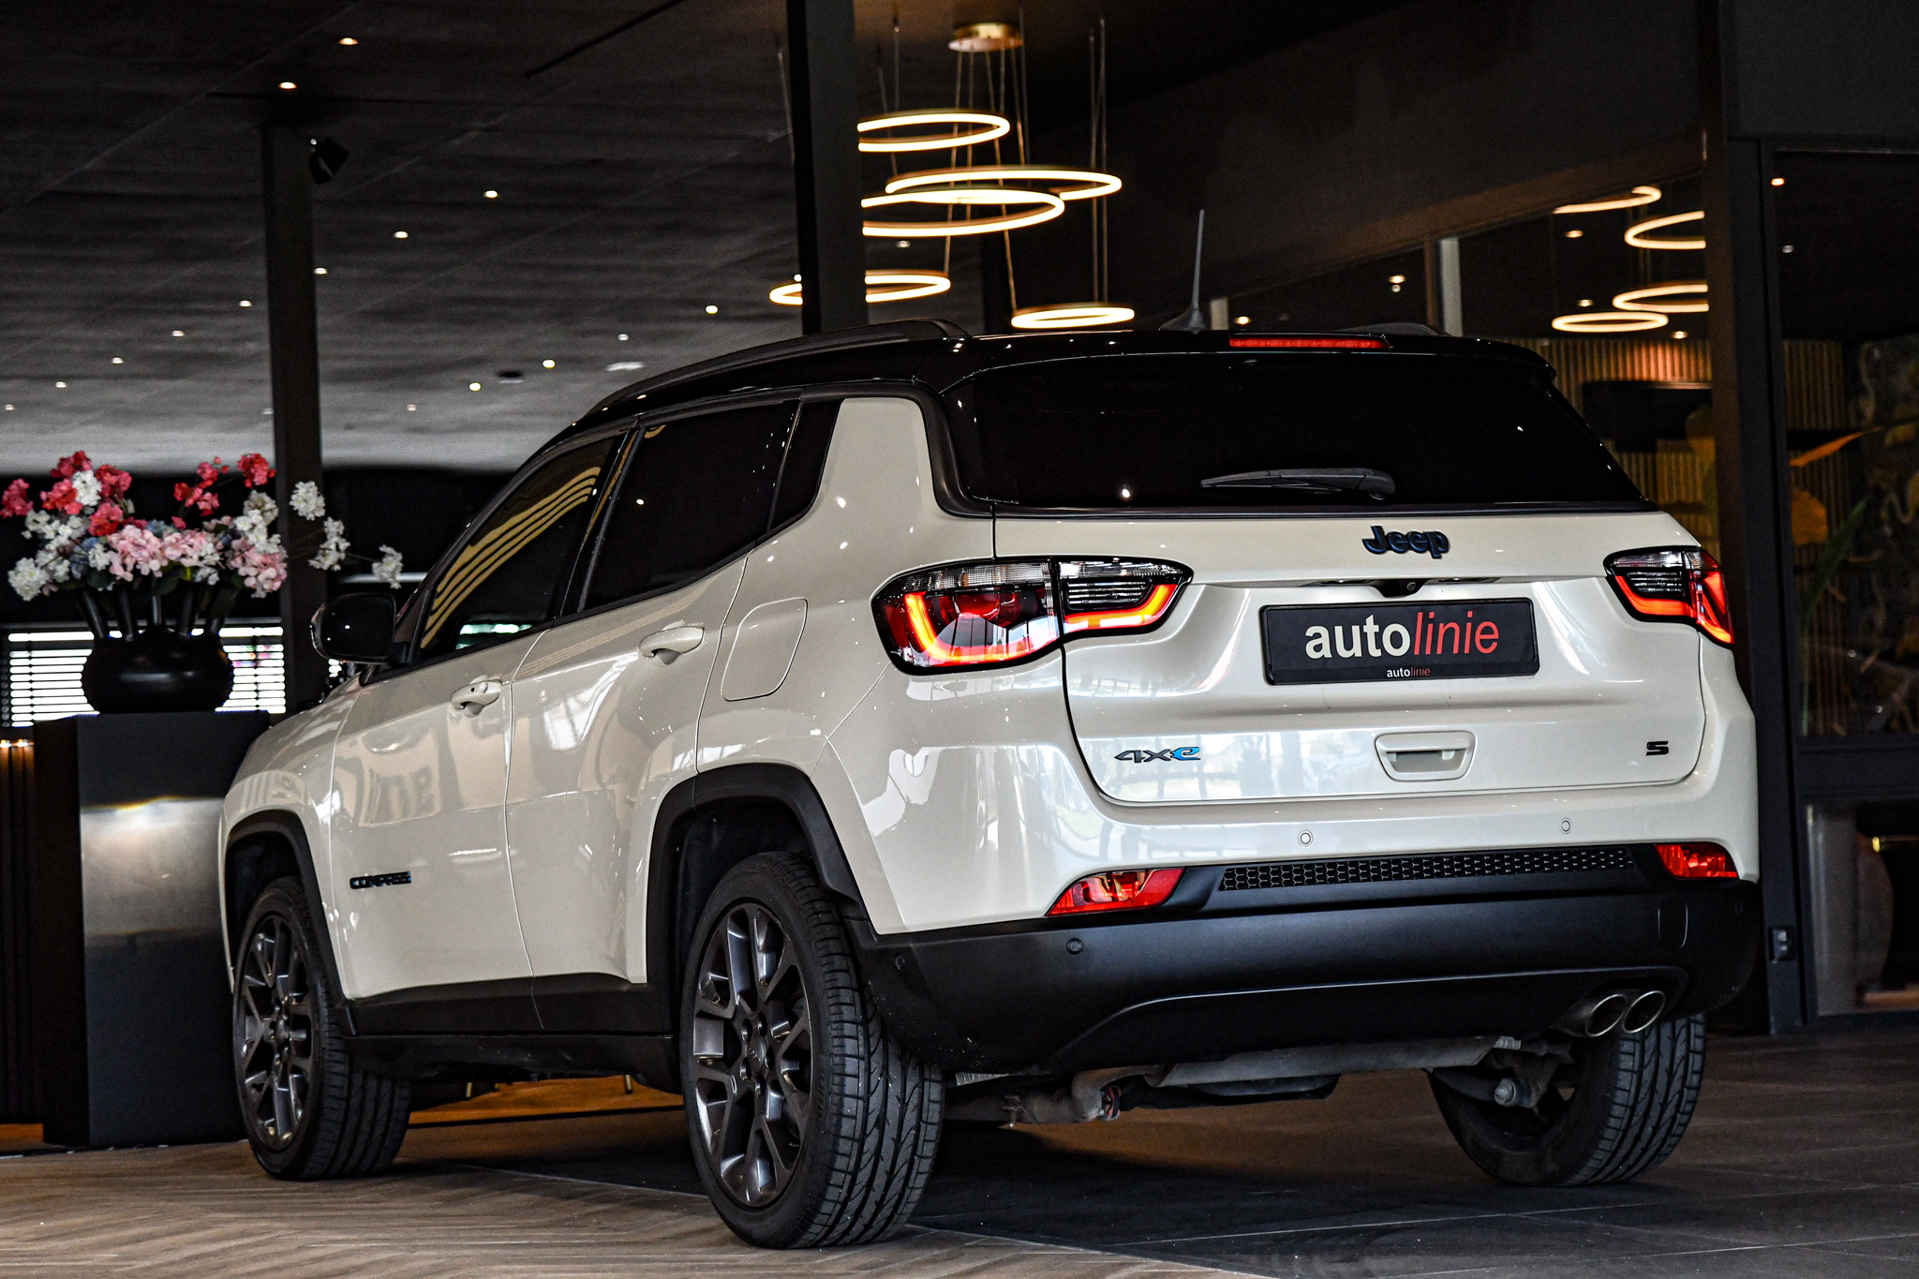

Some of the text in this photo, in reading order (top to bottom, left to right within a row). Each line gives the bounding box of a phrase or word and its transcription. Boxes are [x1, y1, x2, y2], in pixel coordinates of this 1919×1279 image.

[1362, 525, 1450, 559] Jeep
[1305, 611, 1499, 659] autolinie
[1386, 667, 1431, 678] autolinie
[1645, 740, 1669, 756] S
